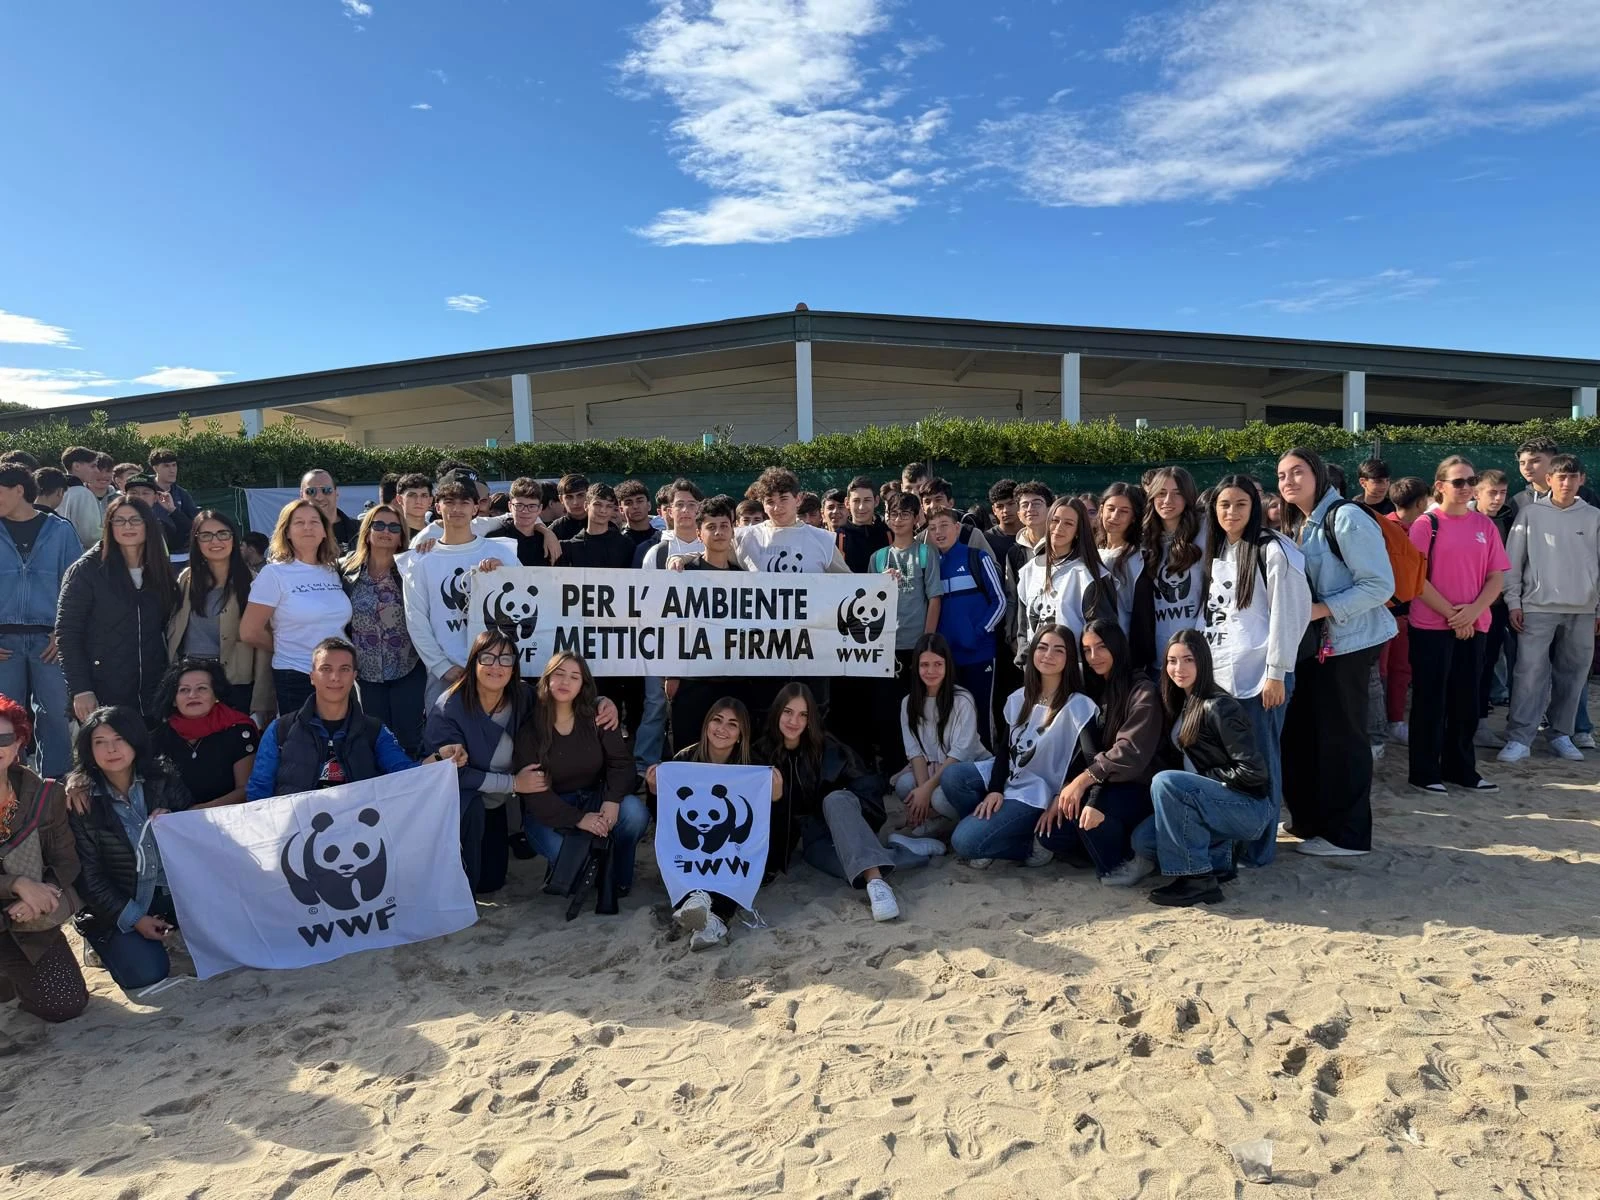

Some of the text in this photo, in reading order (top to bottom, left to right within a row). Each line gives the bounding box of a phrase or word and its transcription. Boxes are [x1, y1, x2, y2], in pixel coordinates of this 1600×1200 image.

[561, 583, 616, 618] PER
[661, 586, 808, 620] AMBIENTE
[1155, 604, 1196, 623] WWF
[553, 626, 664, 660] METTICI
[678, 627, 713, 660] LA
[724, 628, 815, 661] FIRMA
[836, 648, 884, 663] WWF
[297, 903, 397, 948] WWF
